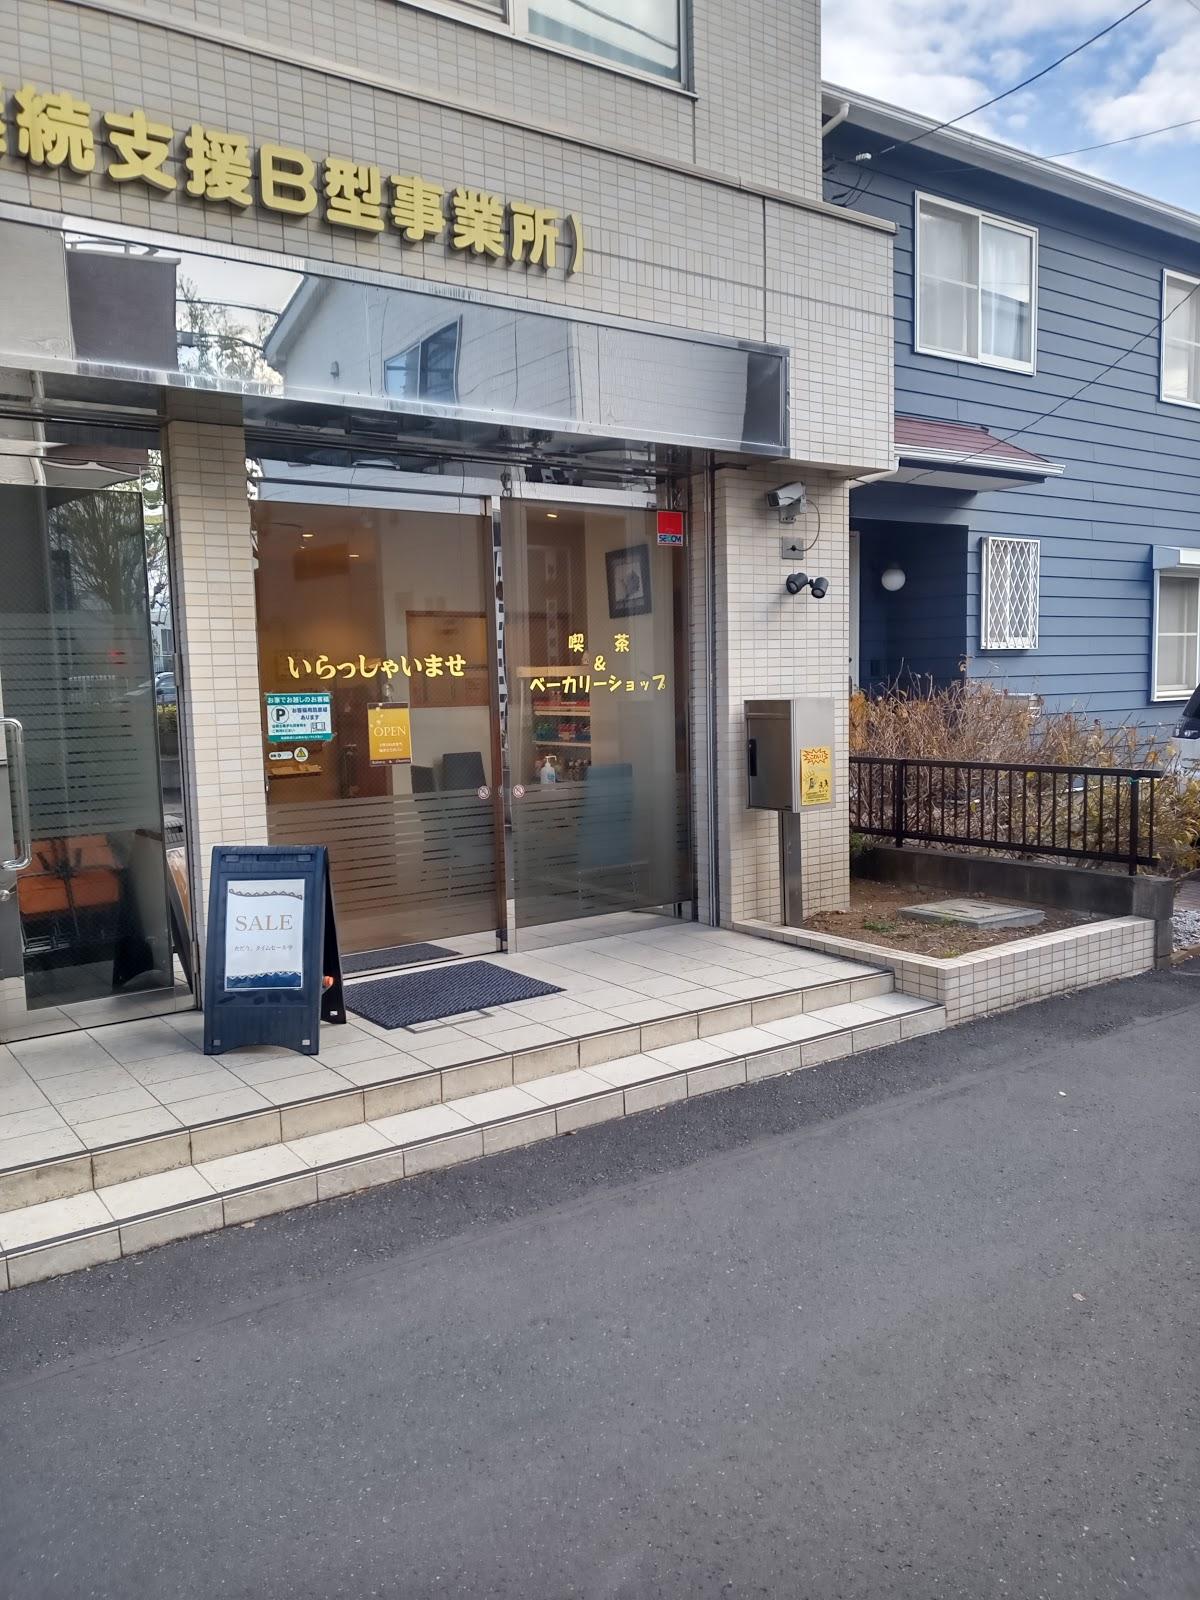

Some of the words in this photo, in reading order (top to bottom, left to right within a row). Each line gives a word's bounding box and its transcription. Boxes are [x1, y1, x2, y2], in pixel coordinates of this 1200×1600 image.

[0, 82, 584, 275] 続支援B型事業所)
[659, 535, 682, 543] SECOM
[287, 654, 466, 680] いらっしゃいませ
[593, 655, 607, 672] &
[529, 674, 666, 694] ベーカリーショップ
[275, 708, 286, 722] P
[373, 726, 407, 737] OPEN
[235, 914, 294, 932] SALE
